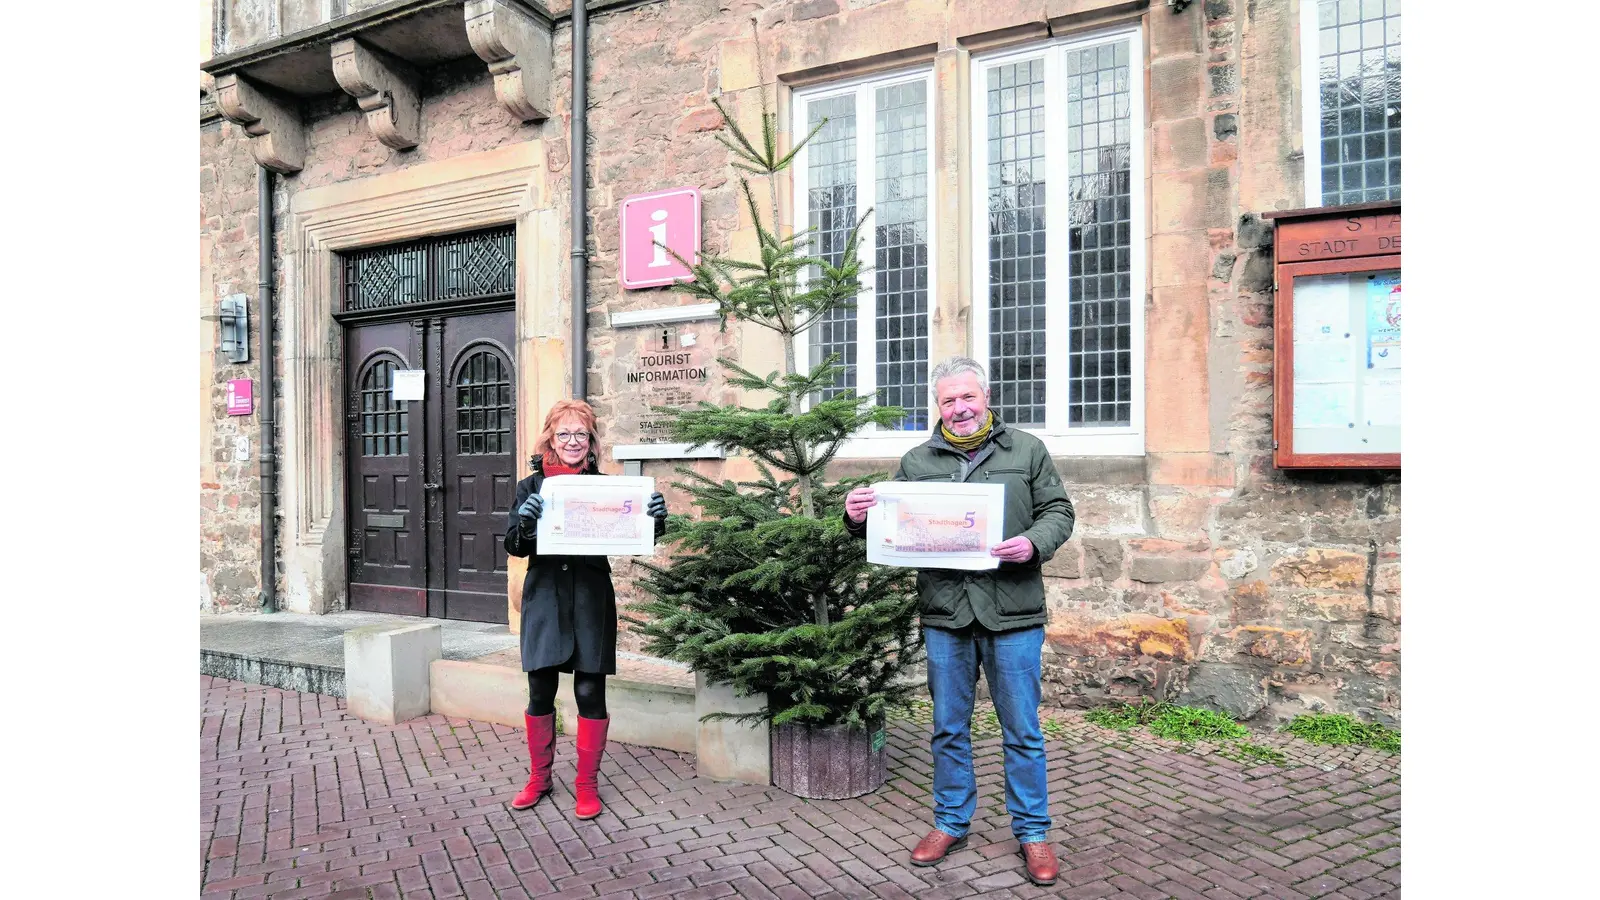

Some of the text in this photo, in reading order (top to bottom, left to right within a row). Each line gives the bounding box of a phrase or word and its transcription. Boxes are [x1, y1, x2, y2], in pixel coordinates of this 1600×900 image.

[1299, 239, 1358, 256] STADT
[641, 353, 691, 366] TOURIST
[627, 367, 707, 383] INFORMATION
[621, 499, 633, 514] 5
[928, 510, 976, 528] Stadthagen 5
